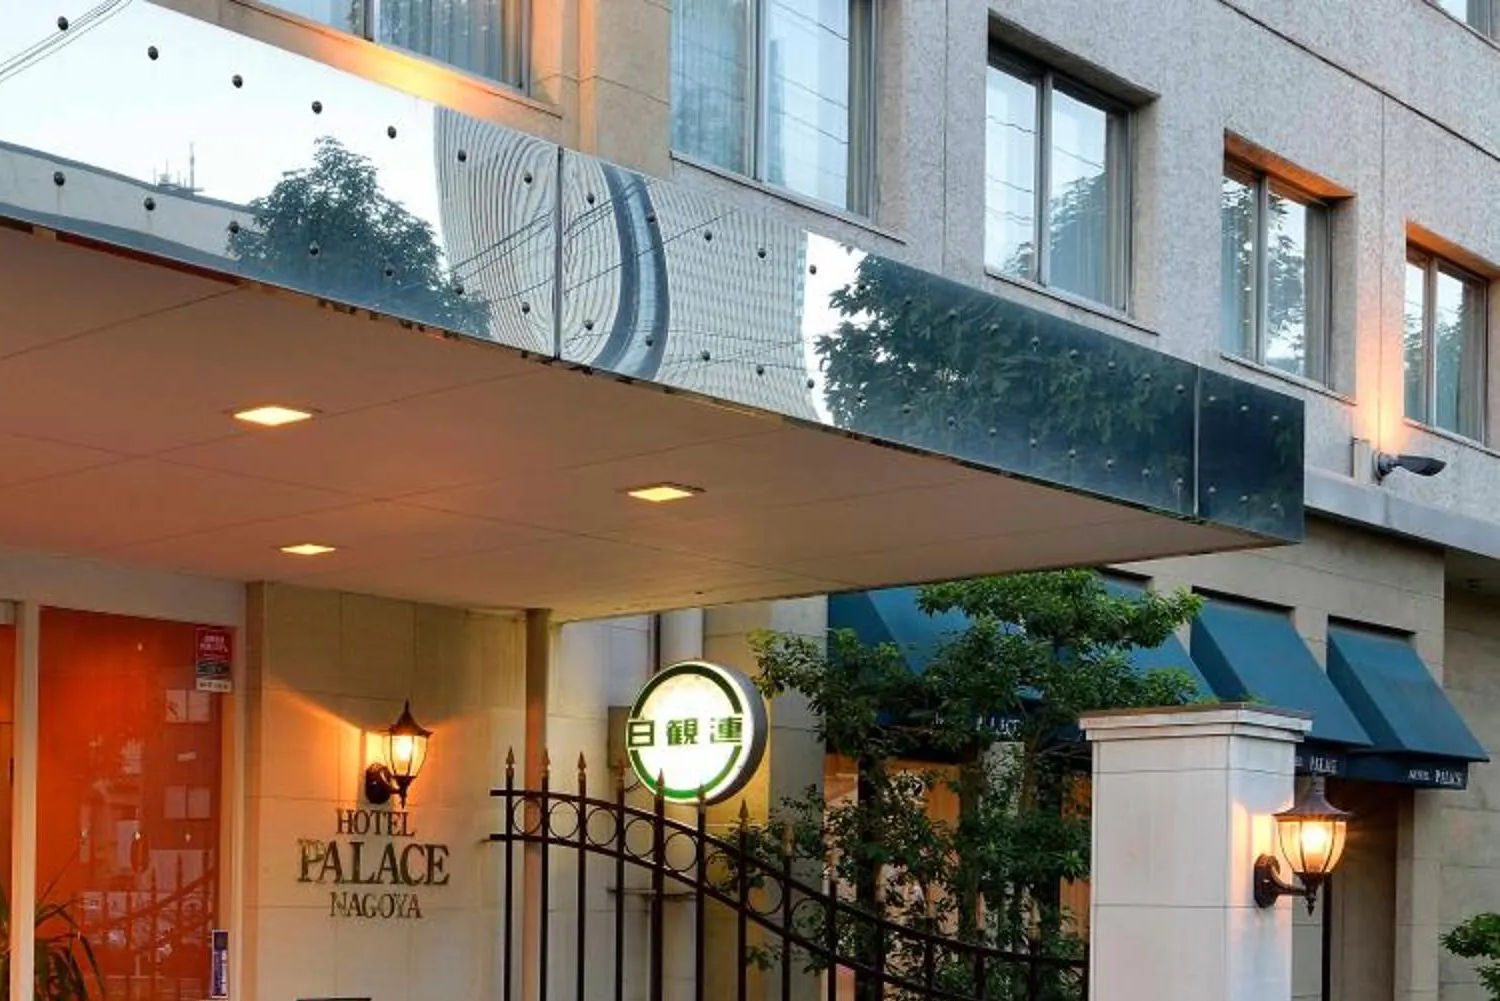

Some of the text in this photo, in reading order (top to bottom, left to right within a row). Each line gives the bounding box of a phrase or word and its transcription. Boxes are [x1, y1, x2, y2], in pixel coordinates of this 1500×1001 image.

[628, 717, 743, 747] 日観連
[336, 808, 417, 837] HOTEL
[297, 838, 451, 886] PALACE
[329, 891, 423, 919] NAGOYA
